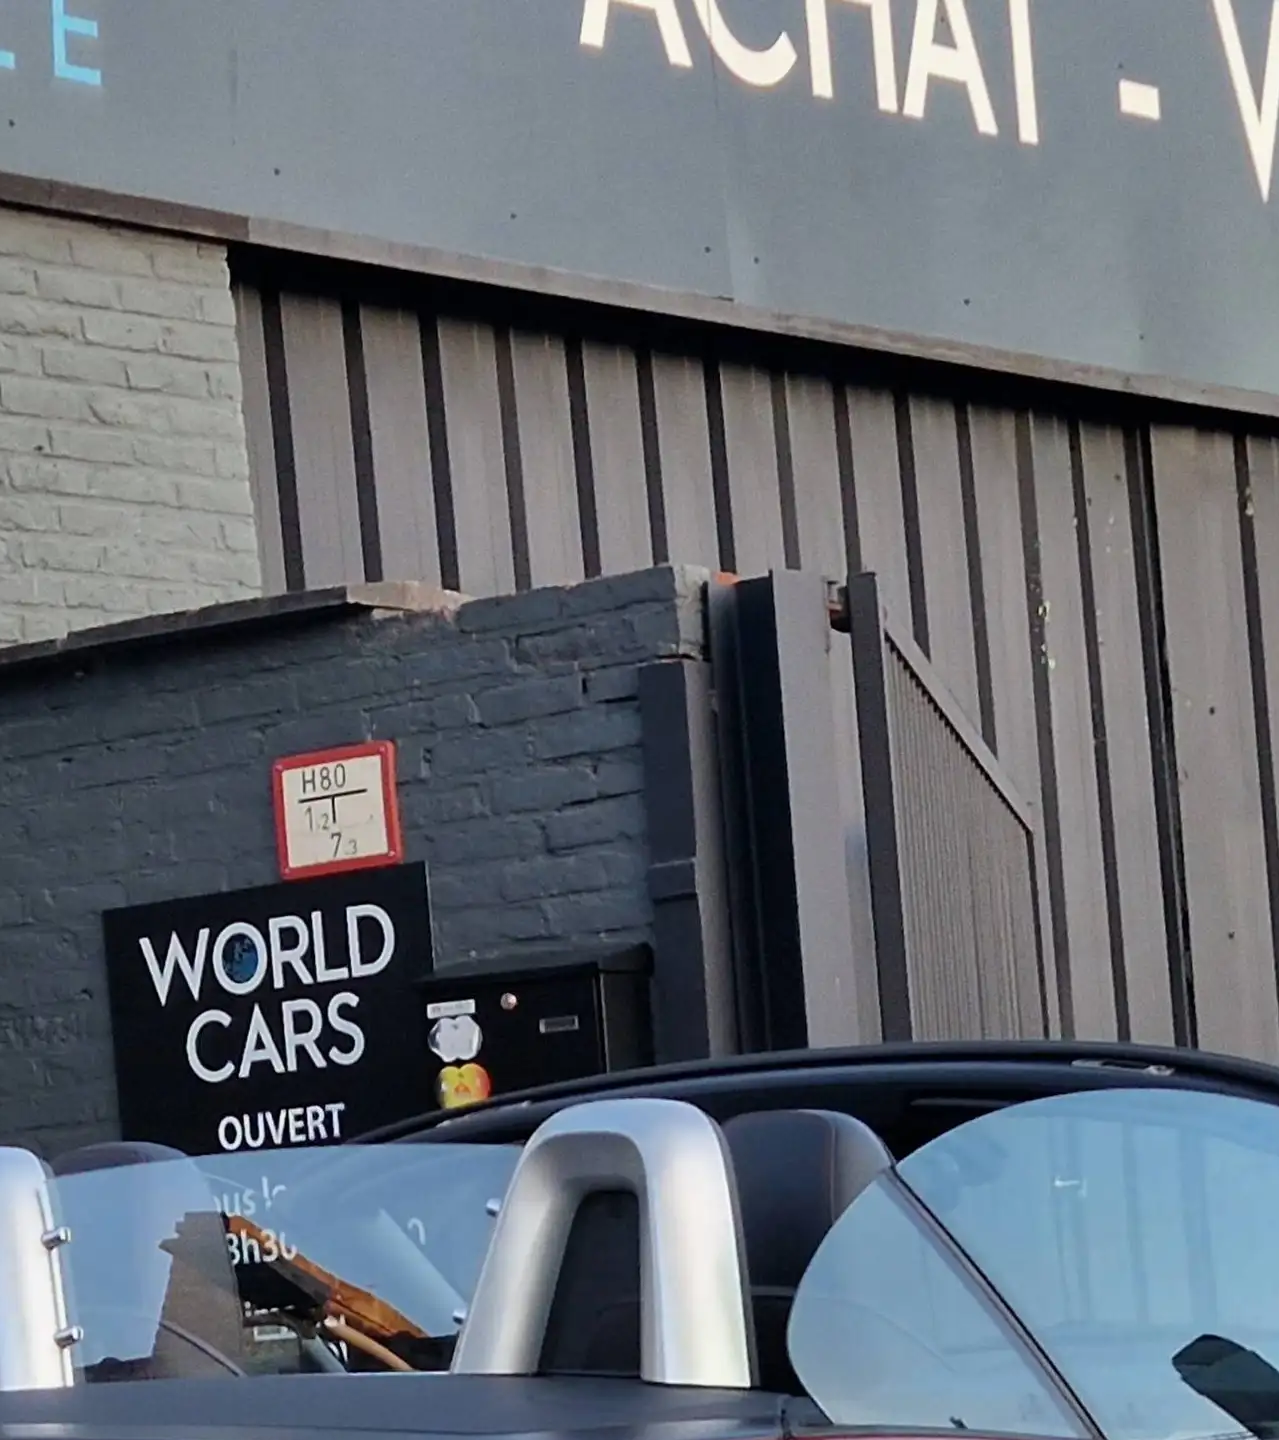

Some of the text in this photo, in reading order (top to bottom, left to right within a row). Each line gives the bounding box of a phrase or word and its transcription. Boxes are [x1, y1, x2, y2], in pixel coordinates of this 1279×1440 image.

[301, 763, 346, 793] H80
[139, 904, 395, 1005] WORLD
[186, 992, 365, 1082] CARS
[218, 1102, 345, 1150] OUVERT
